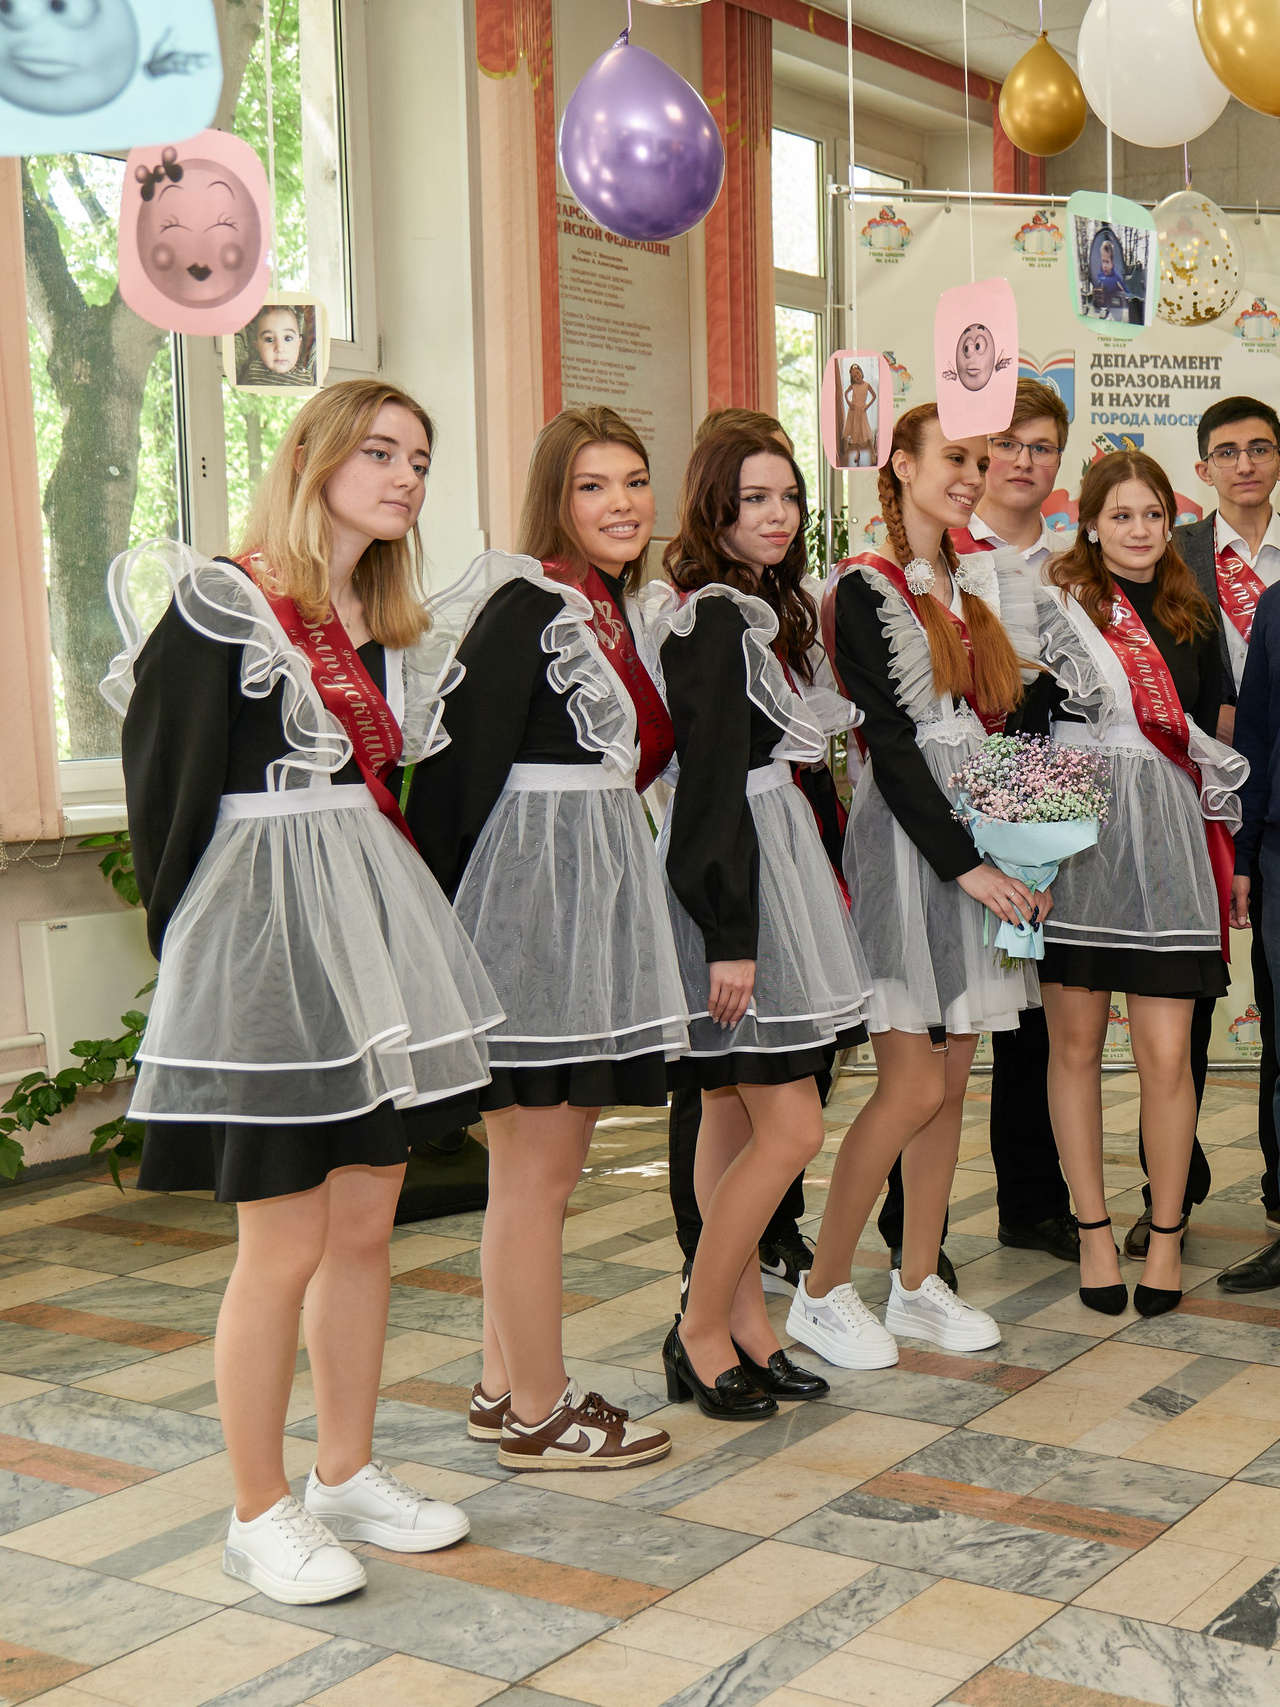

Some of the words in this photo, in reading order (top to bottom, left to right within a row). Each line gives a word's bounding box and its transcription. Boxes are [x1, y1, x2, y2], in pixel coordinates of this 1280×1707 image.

[560, 220, 602, 241] ЙСКОЙ
[1090, 353, 1222, 371] ДЕПАРТАМЕНТ
[1090, 373, 1222, 390] ОБРАЗОВАНИЯ
[1090, 392, 1104, 407] И
[1108, 392, 1170, 408] НАУКИ
[1090, 412, 1150, 427] ГОРОДА
[1215, 557, 1257, 616] Выпу
